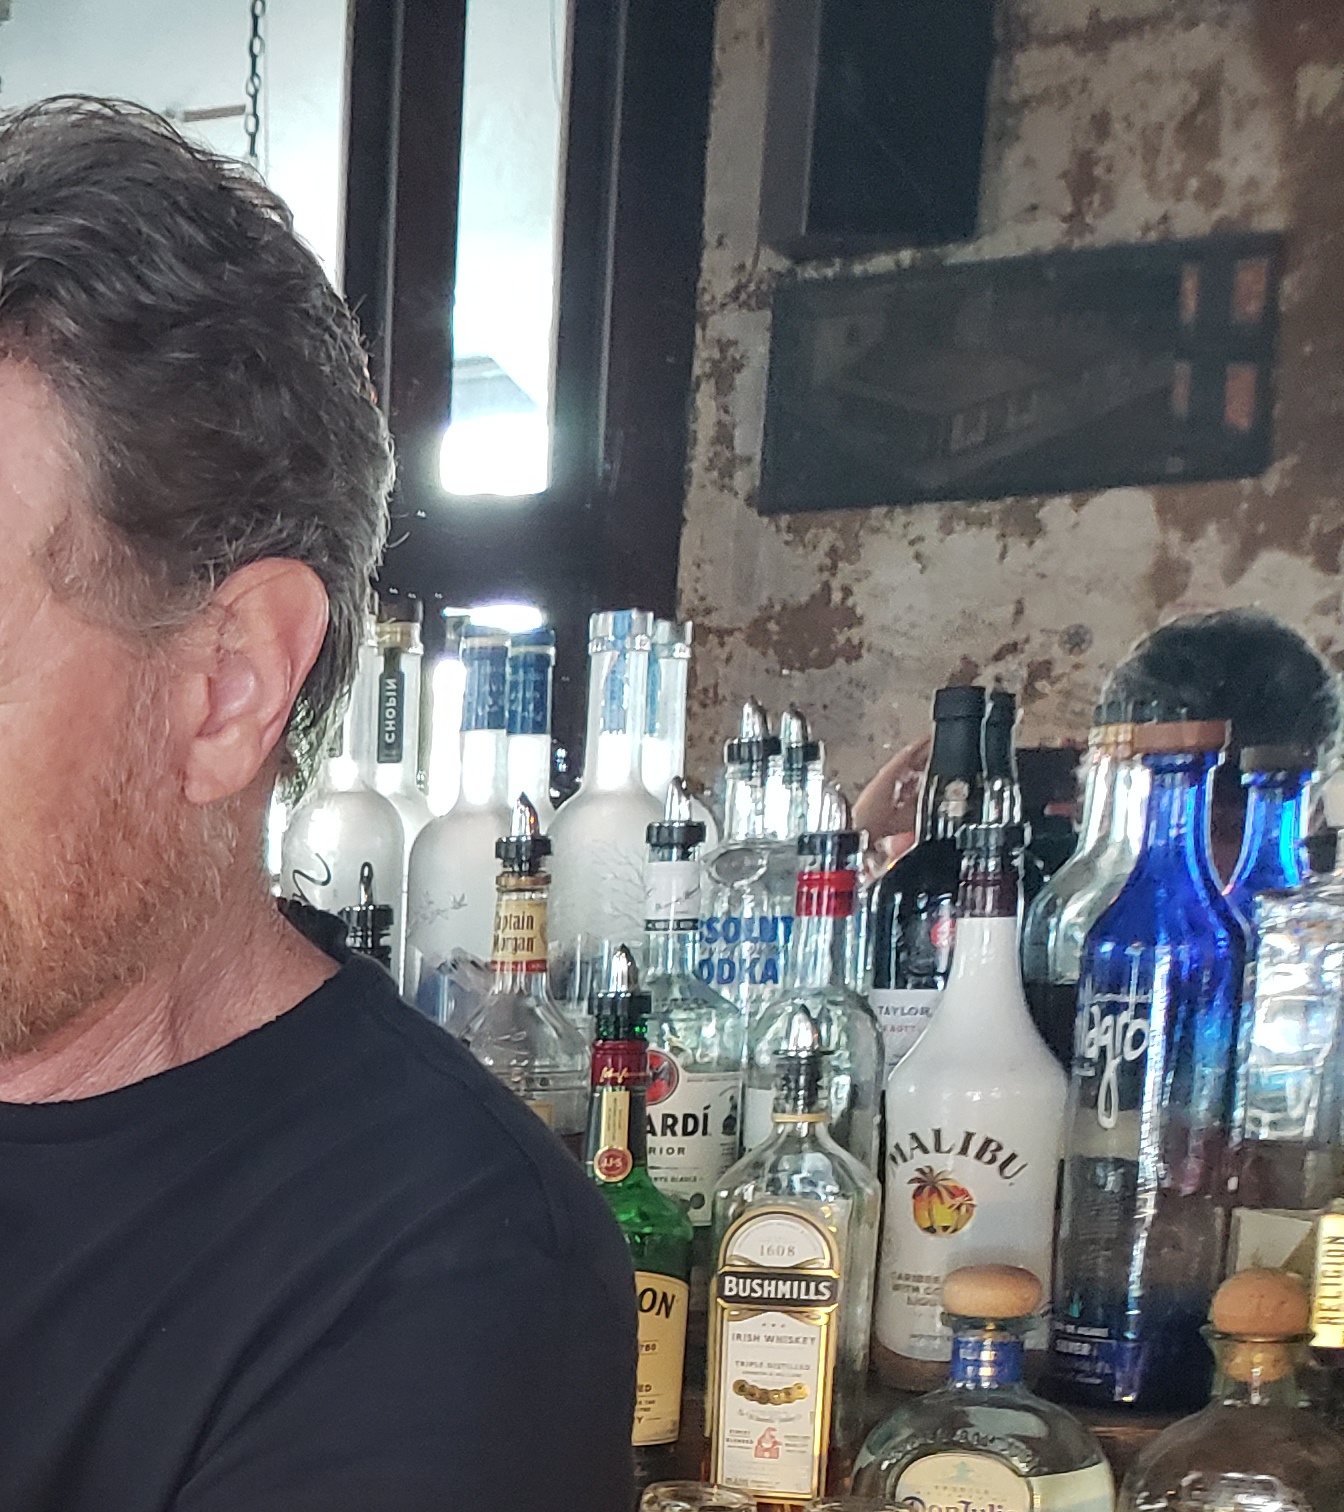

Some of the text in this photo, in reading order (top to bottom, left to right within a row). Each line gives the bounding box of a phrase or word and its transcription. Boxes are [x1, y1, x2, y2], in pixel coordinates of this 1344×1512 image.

[759, 1243, 796, 1258] 1608
[723, 1275, 833, 1301] BUSHMILLS
[732, 1332, 817, 1346] IRISH WHISKEY
